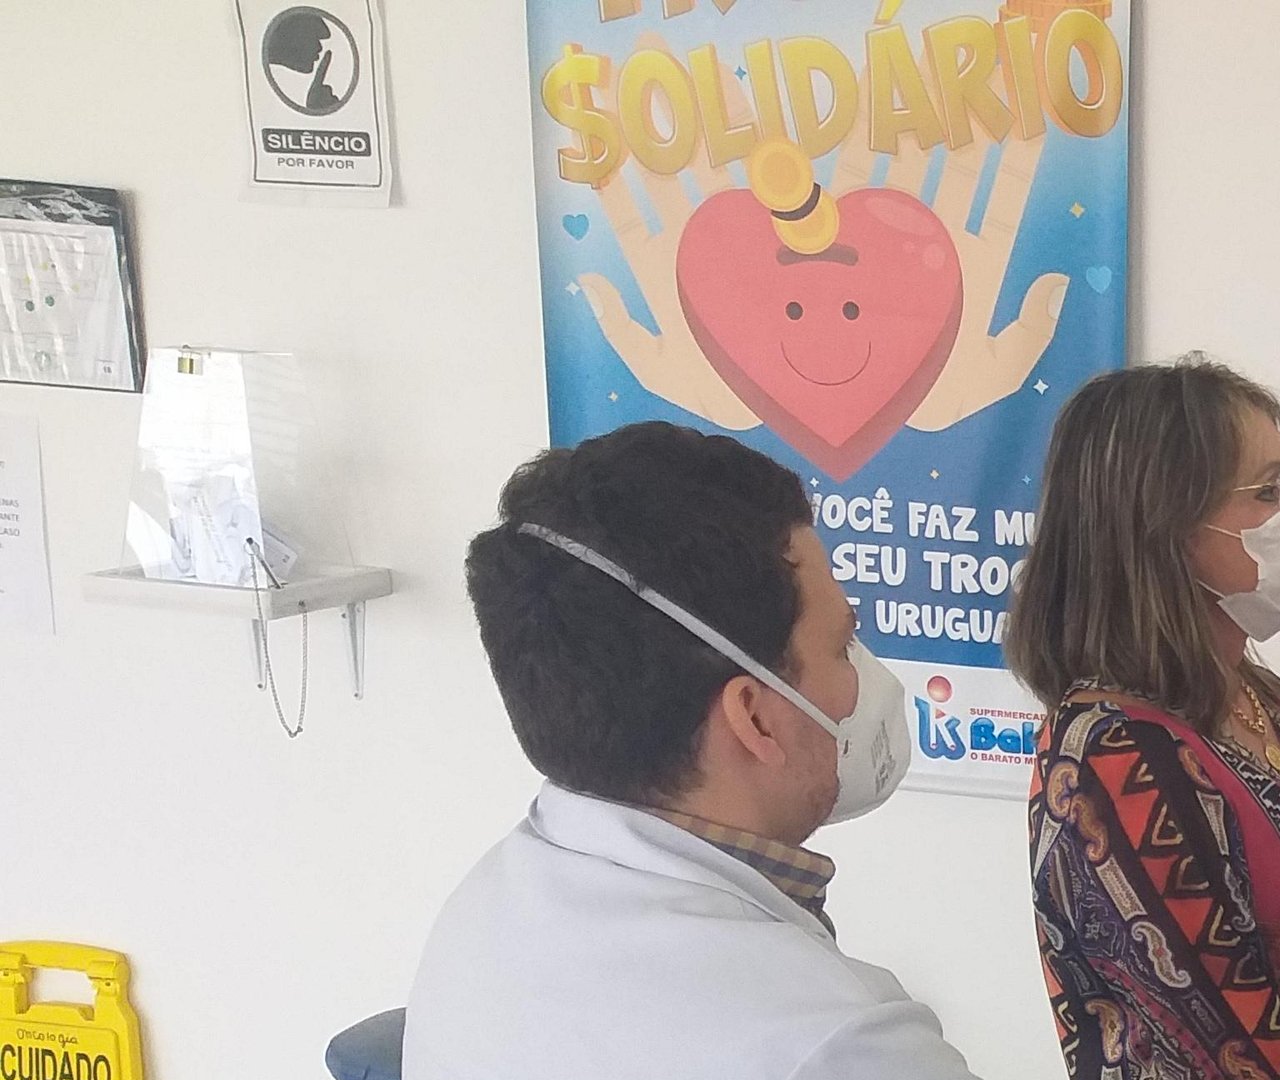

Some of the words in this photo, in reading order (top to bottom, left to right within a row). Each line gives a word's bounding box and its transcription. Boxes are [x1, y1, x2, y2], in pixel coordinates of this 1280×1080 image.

[267, 132, 367, 152] SILÊNCIO
[277, 157, 305, 168] POR
[309, 158, 355, 169] FAVOR
[908, 501, 979, 542] FAZ
[832, 543, 906, 586] SEU
[970, 752, 978, 761] O
[981, 753, 1021, 764] BARATO
